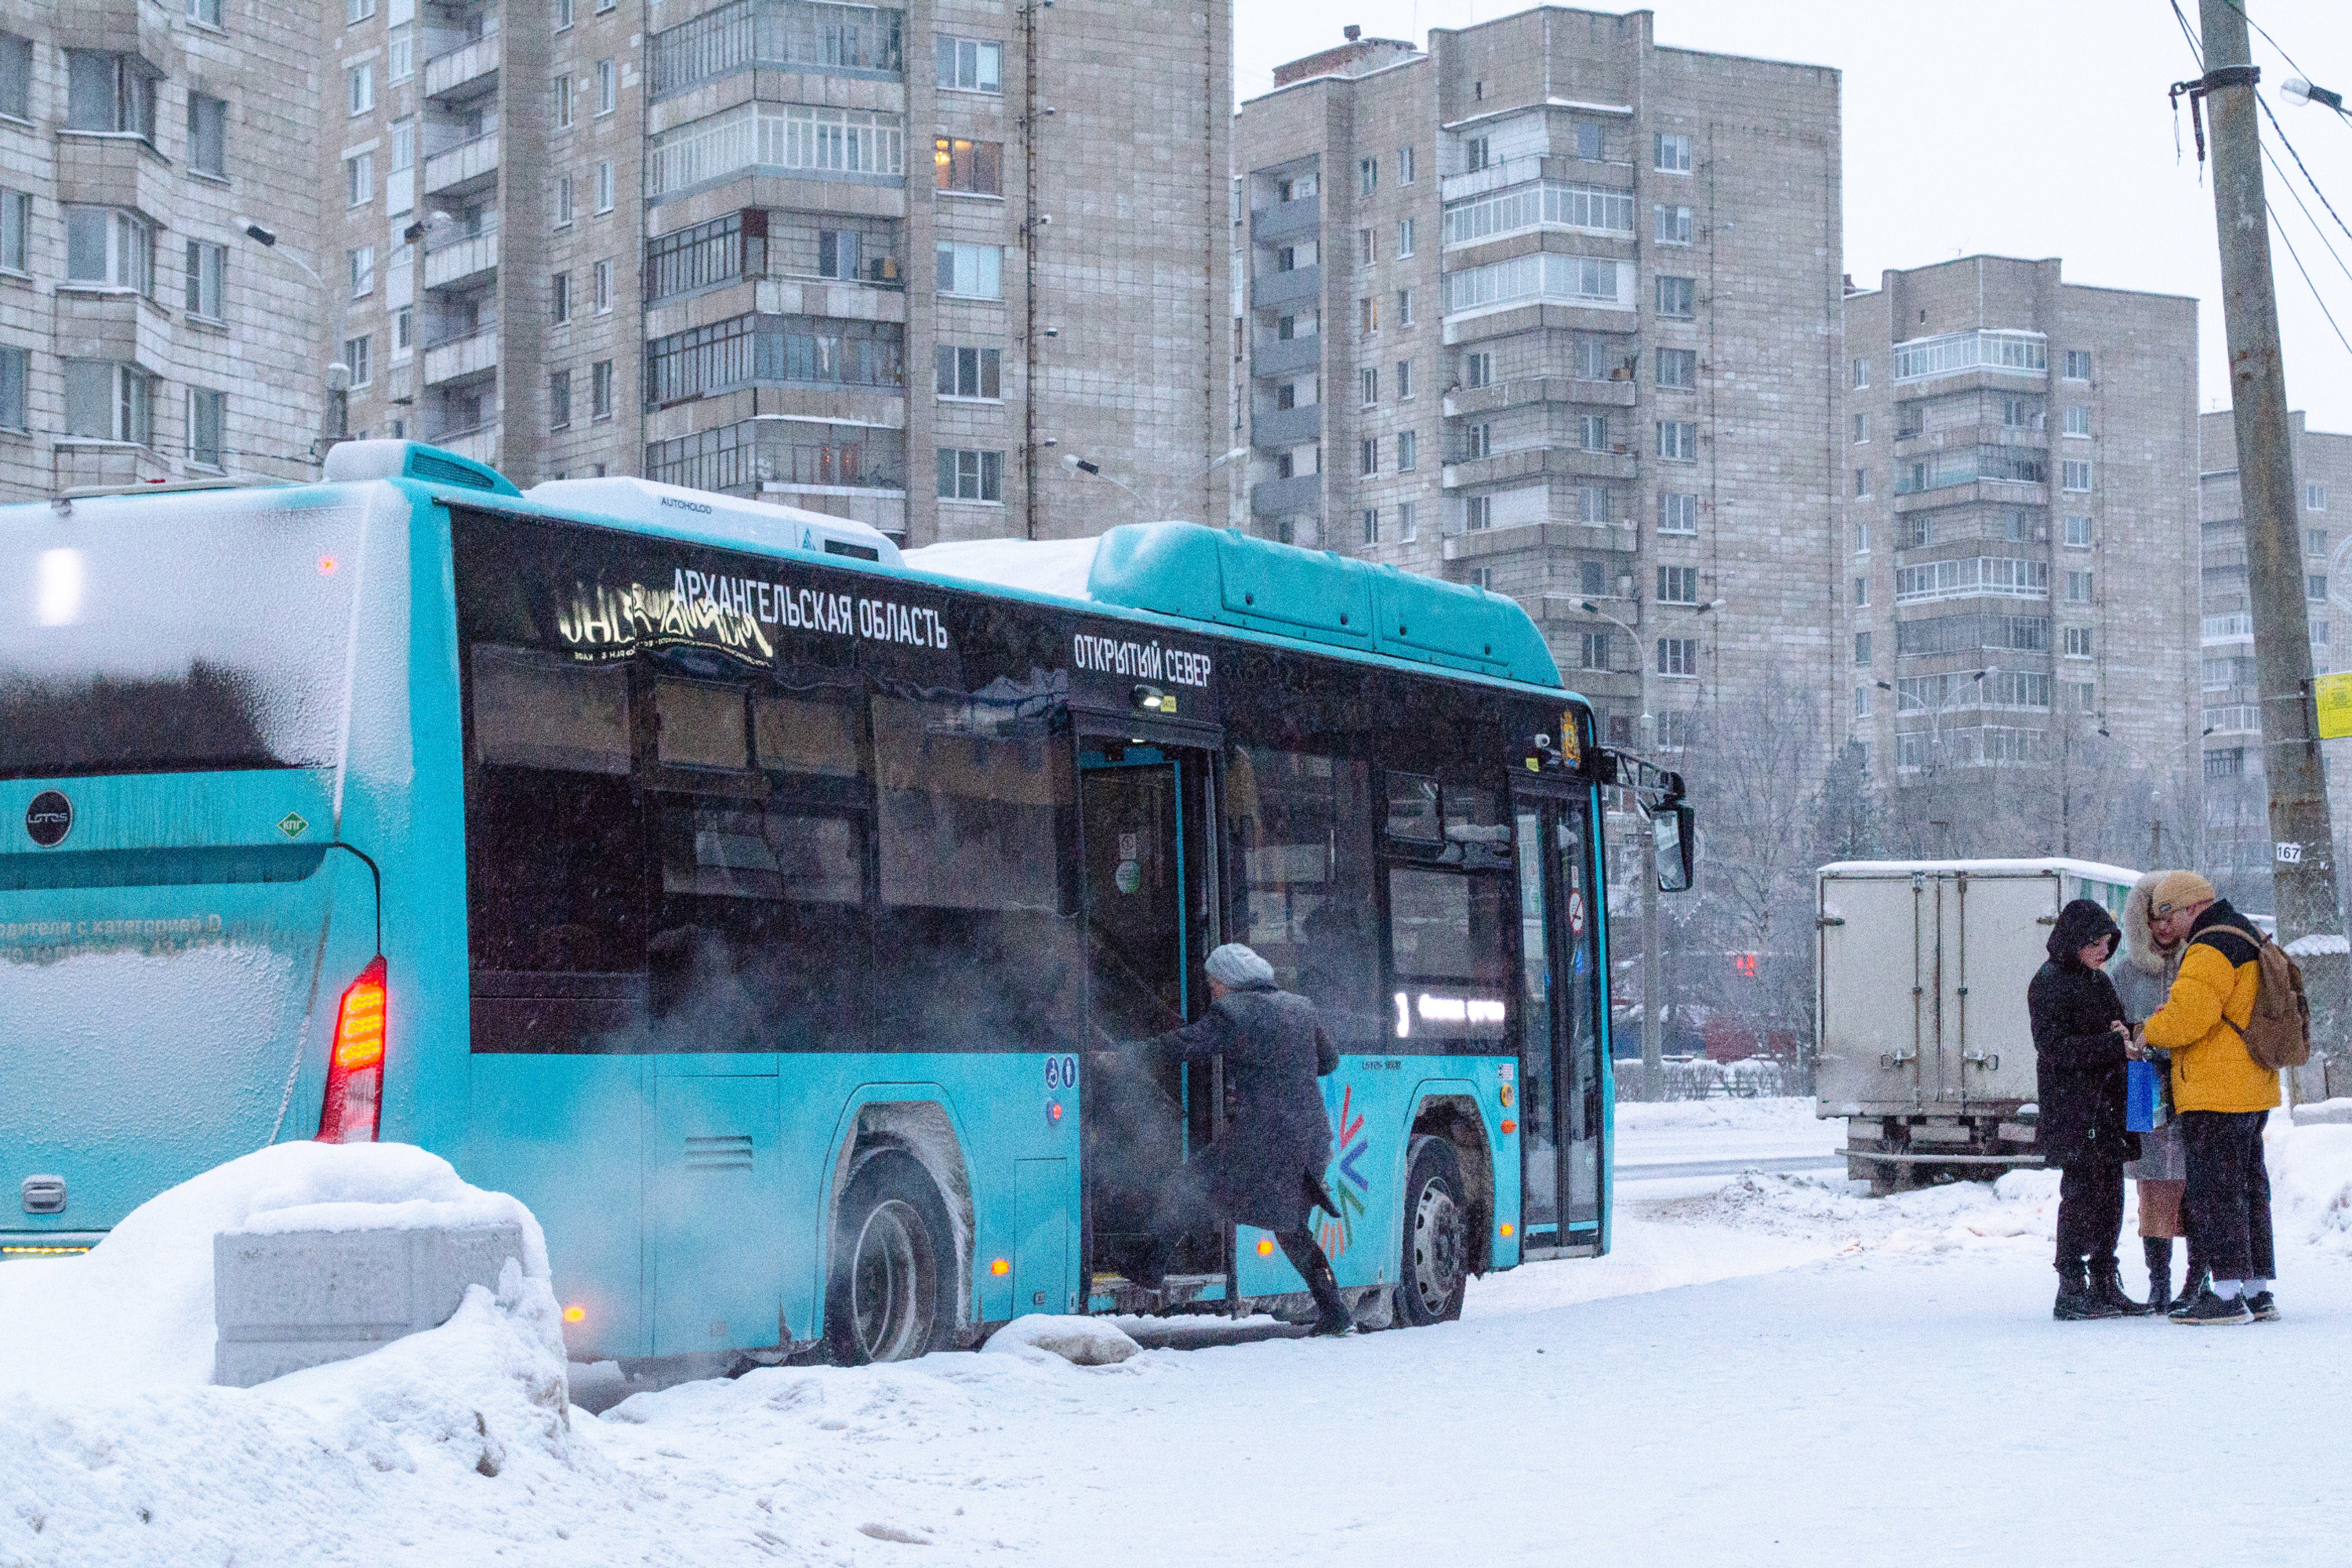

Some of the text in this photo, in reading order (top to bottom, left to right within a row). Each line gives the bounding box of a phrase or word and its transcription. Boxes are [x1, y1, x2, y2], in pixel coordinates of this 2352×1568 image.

[661, 497, 713, 515] AUTOHOLOD
[673, 568, 854, 635] АРХАНГЕЛЬСКАЯ
[858, 598, 949, 649] ОБЛАСТЬ
[1074, 633, 1211, 688] ОТКРЫТЫЙ СЕВЕР
[2278, 847, 2299, 859] 167
[208, 913, 222, 933] D
